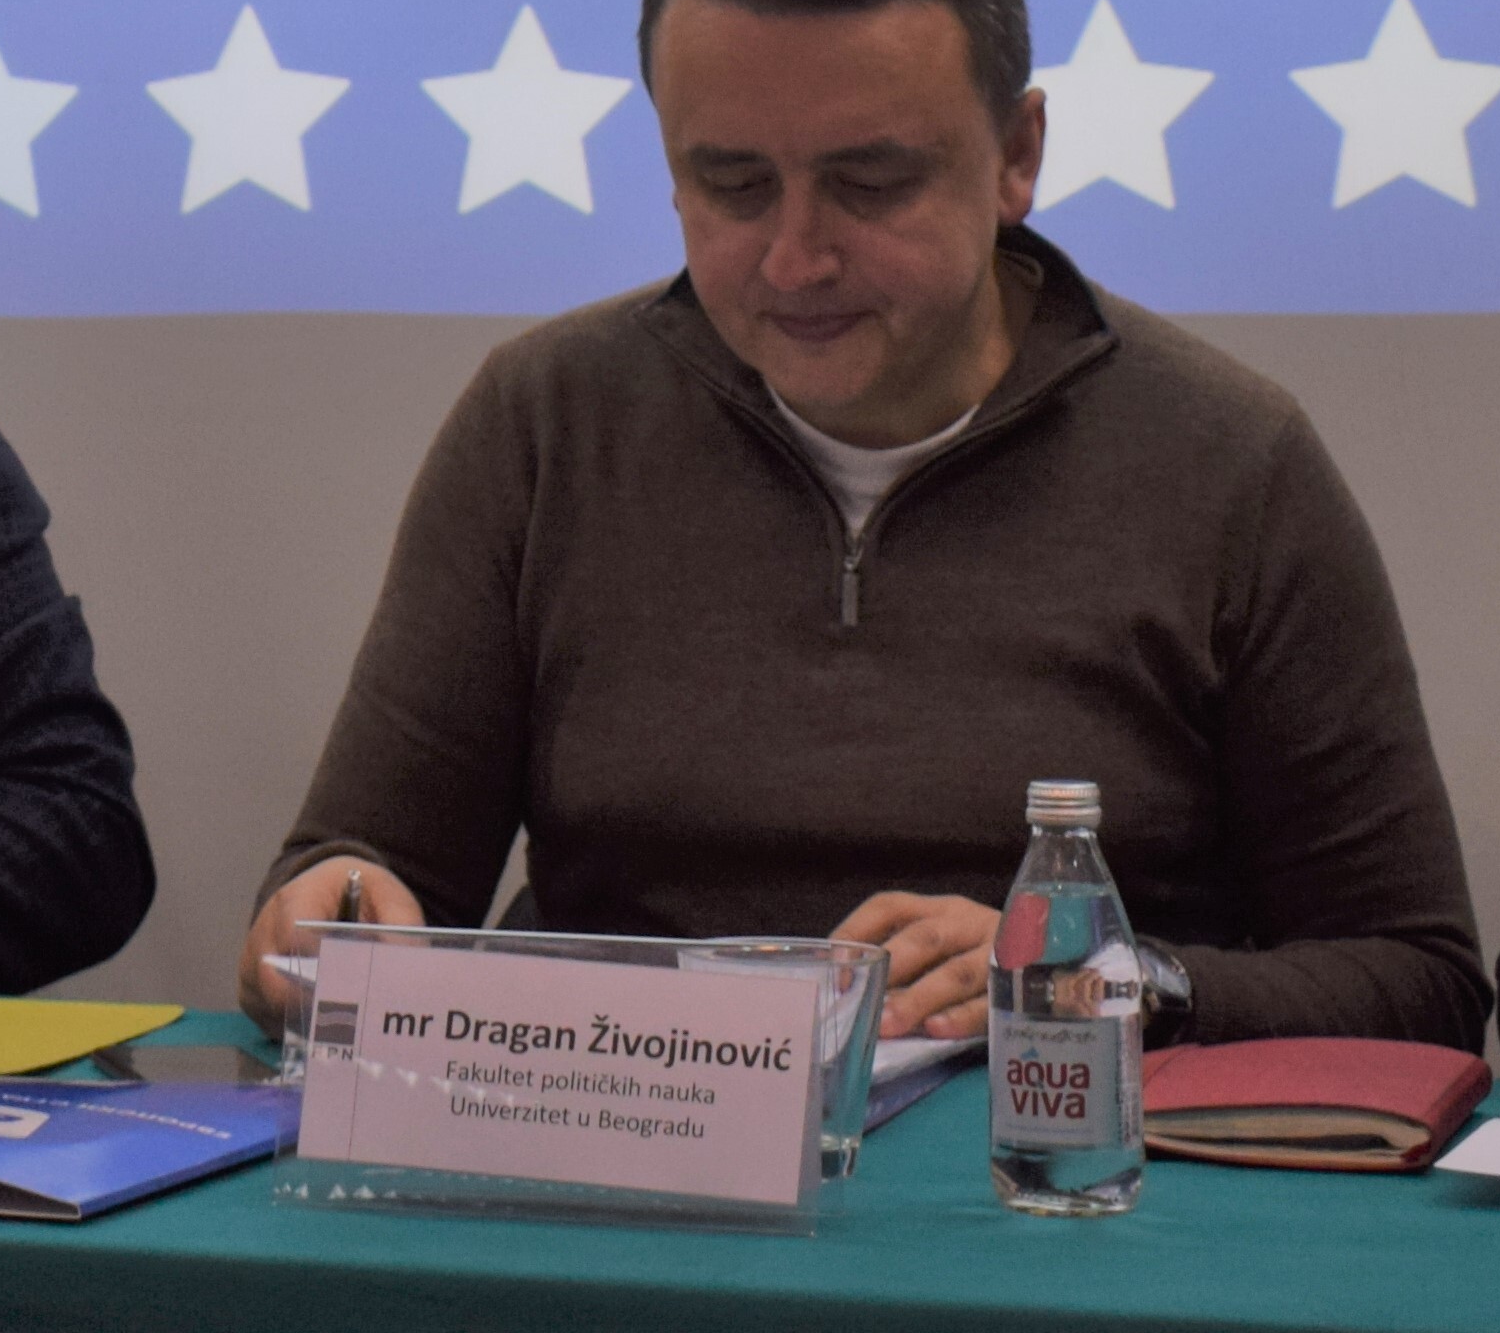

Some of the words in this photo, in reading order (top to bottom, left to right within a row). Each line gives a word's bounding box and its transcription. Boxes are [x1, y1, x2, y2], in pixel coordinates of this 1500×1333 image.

[382, 1009, 434, 1038] mr
[444, 1008, 578, 1055] Dragan
[587, 1013, 793, 1072] Živojinović
[445, 1059, 535, 1089] Fakultet
[540, 1065, 642, 1099] političkih
[648, 1082, 717, 1106] nauka
[1006, 1057, 1091, 1090] aqua
[449, 1095, 572, 1127] Univerzitet
[576, 1111, 591, 1128] u
[597, 1109, 706, 1139] Beogradu
[1010, 1088, 1087, 1120] viva
